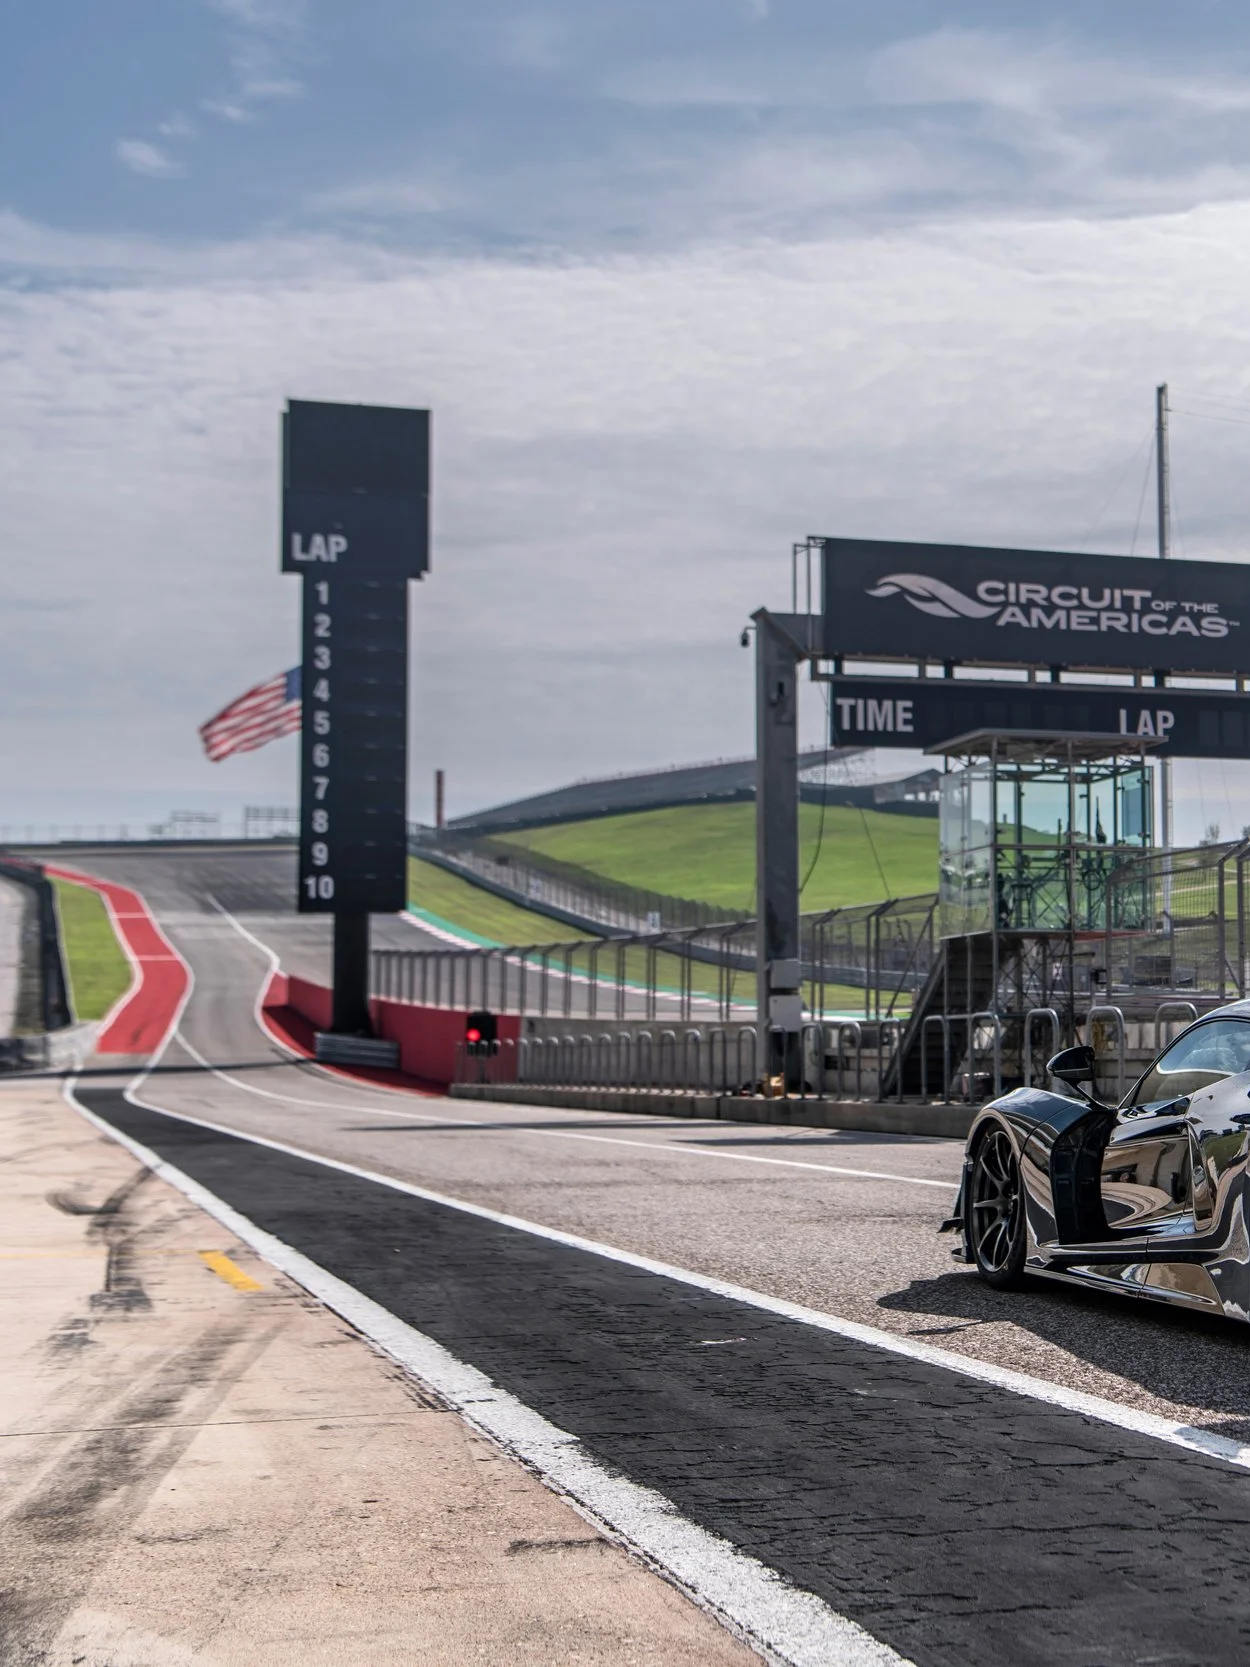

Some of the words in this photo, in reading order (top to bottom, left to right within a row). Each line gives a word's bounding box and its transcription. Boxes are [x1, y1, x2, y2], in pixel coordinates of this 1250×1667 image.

[291, 532, 348, 563] LAP
[315, 580, 329, 605] 1
[976, 579, 1152, 610] CIRCUIT
[1151, 600, 1175, 612] OF
[1180, 602, 1219, 614] THE
[313, 612, 331, 637] 2
[313, 645, 331, 670] 3
[312, 678, 330, 702] 4
[313, 710, 331, 735] 5
[836, 698, 914, 733] TIME
[1119, 708, 1175, 737] LAP
[312, 743, 330, 768] 6
[312, 776, 330, 800] 7
[311, 809, 329, 834] 8
[311, 841, 329, 867] 9
[304, 874, 335, 900] 10
